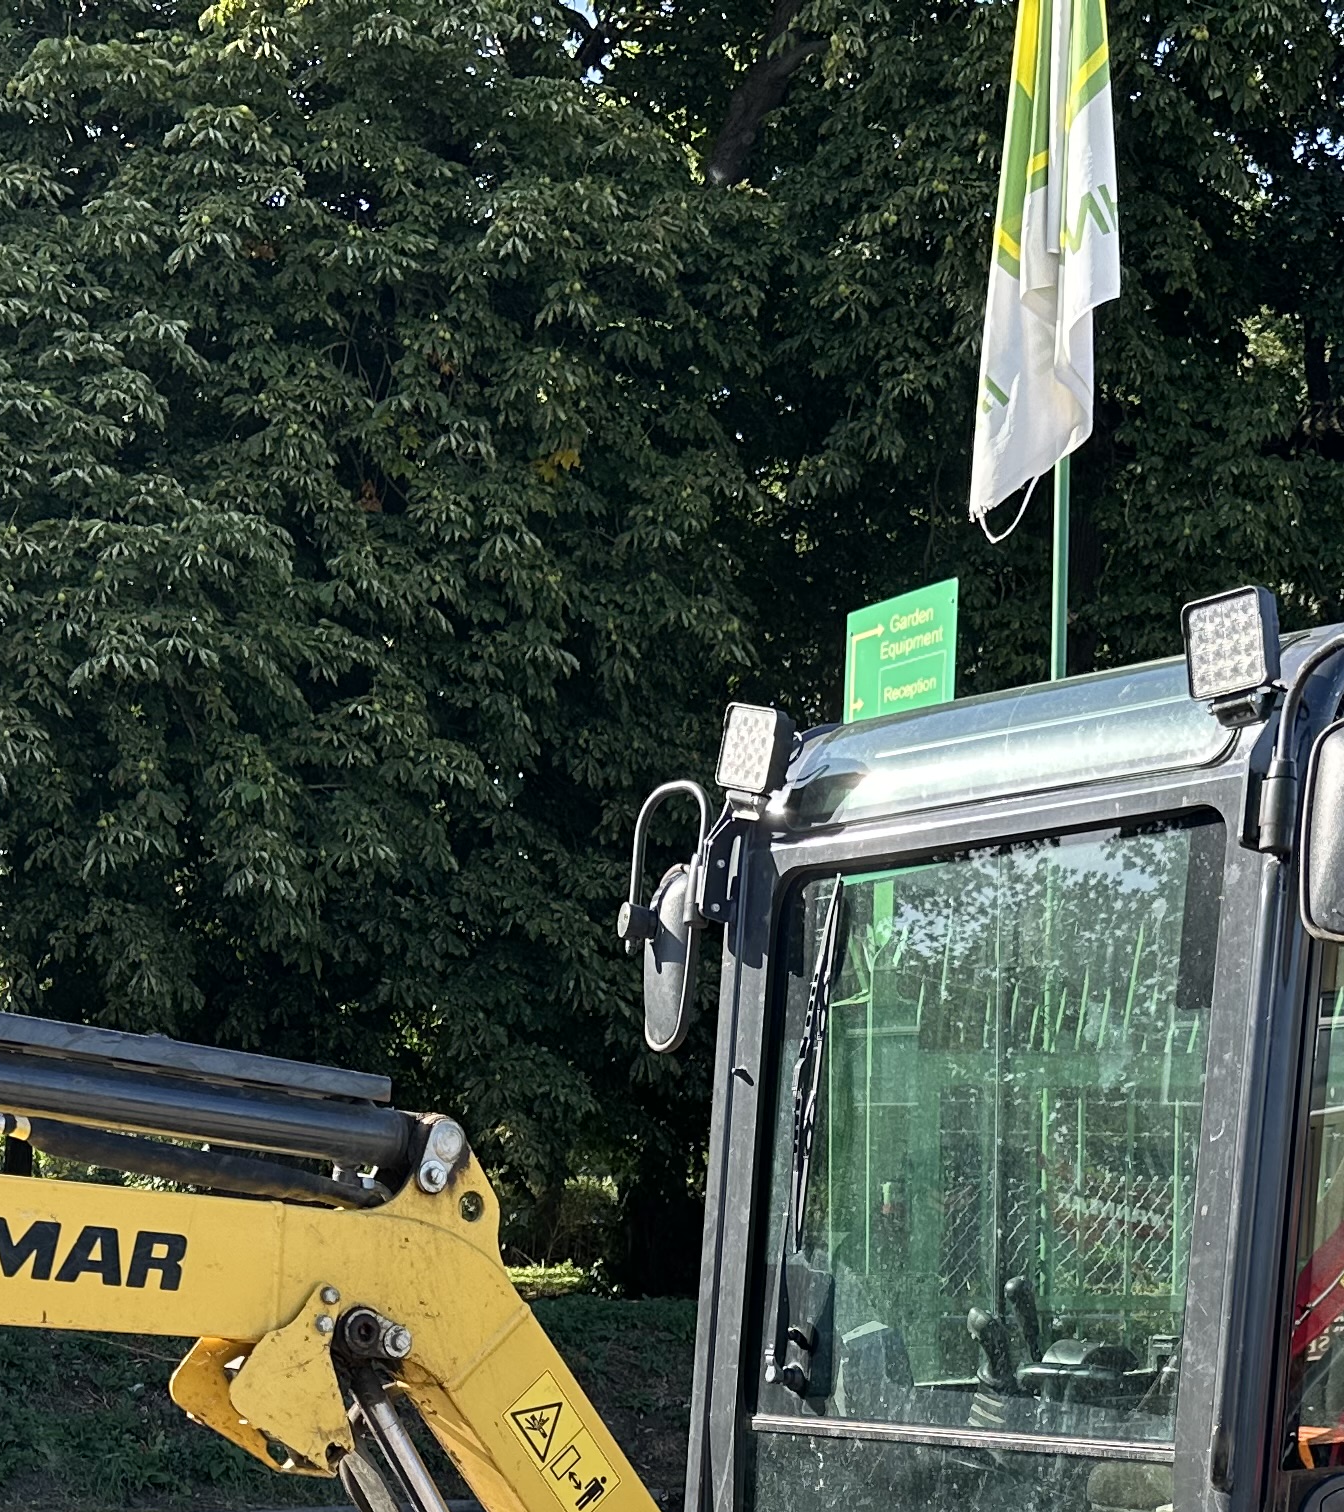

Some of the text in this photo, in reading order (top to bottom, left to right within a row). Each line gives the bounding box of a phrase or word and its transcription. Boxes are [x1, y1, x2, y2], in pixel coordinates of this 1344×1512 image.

[889, 607, 934, 633] Garden
[879, 625, 944, 660] Equipment
[883, 676, 937, 703] Reception
